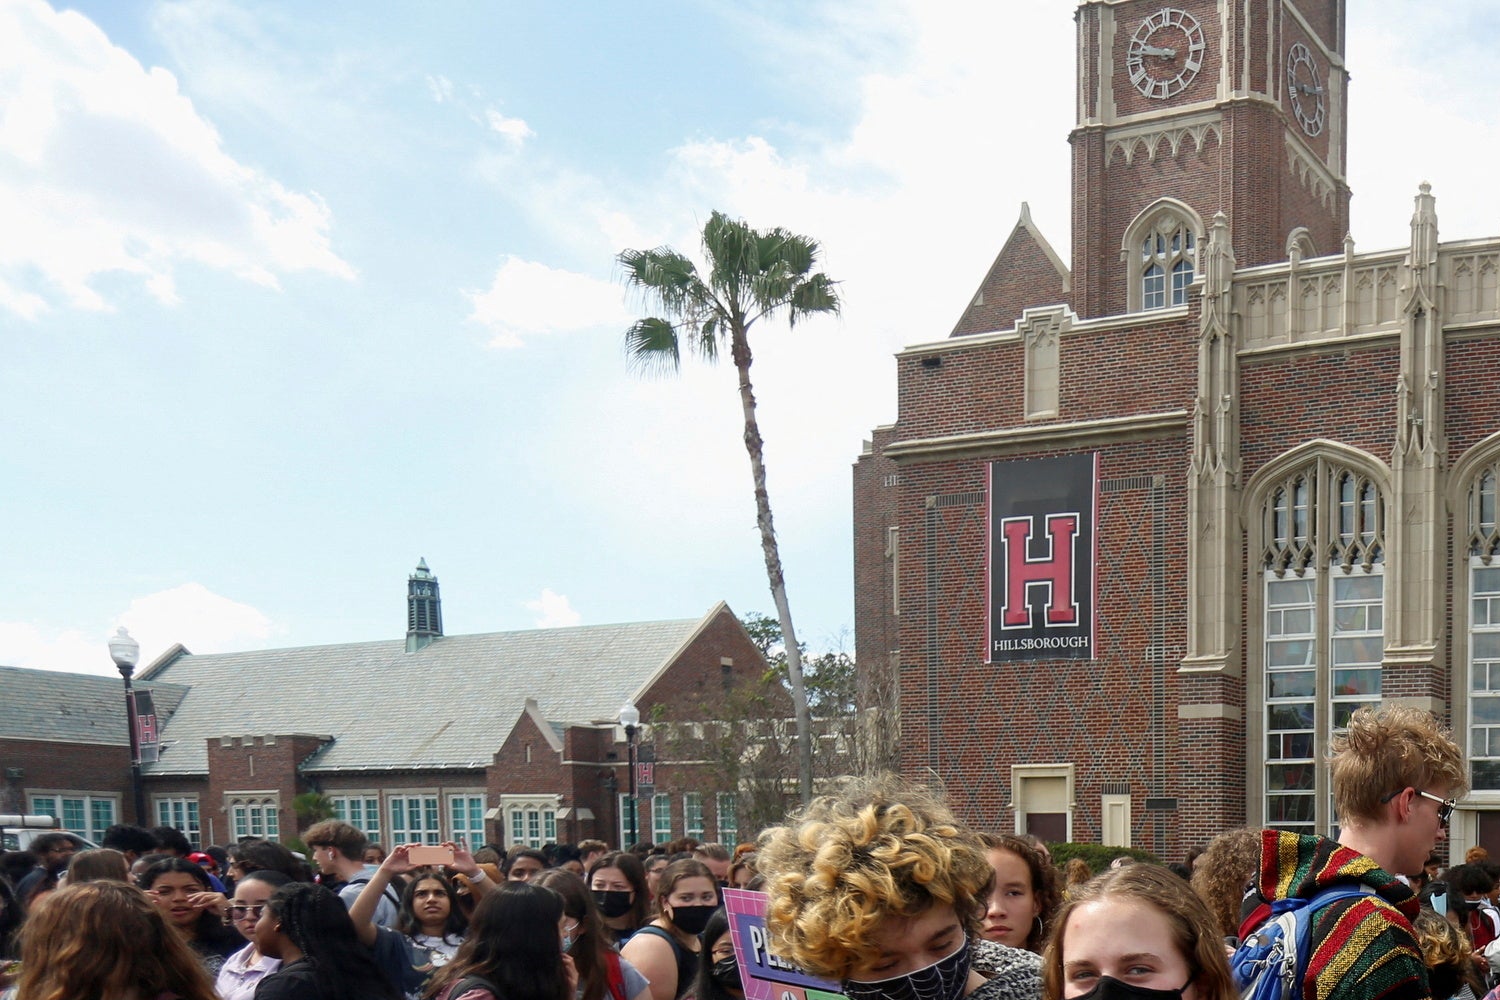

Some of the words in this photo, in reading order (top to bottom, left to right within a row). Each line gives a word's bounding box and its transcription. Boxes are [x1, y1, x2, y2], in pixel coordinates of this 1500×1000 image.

[1001, 512, 1080, 631] H
[994, 636, 1088, 652] HILLSBOROUGH
[138, 715, 156, 744] H
[638, 762, 654, 784] H
